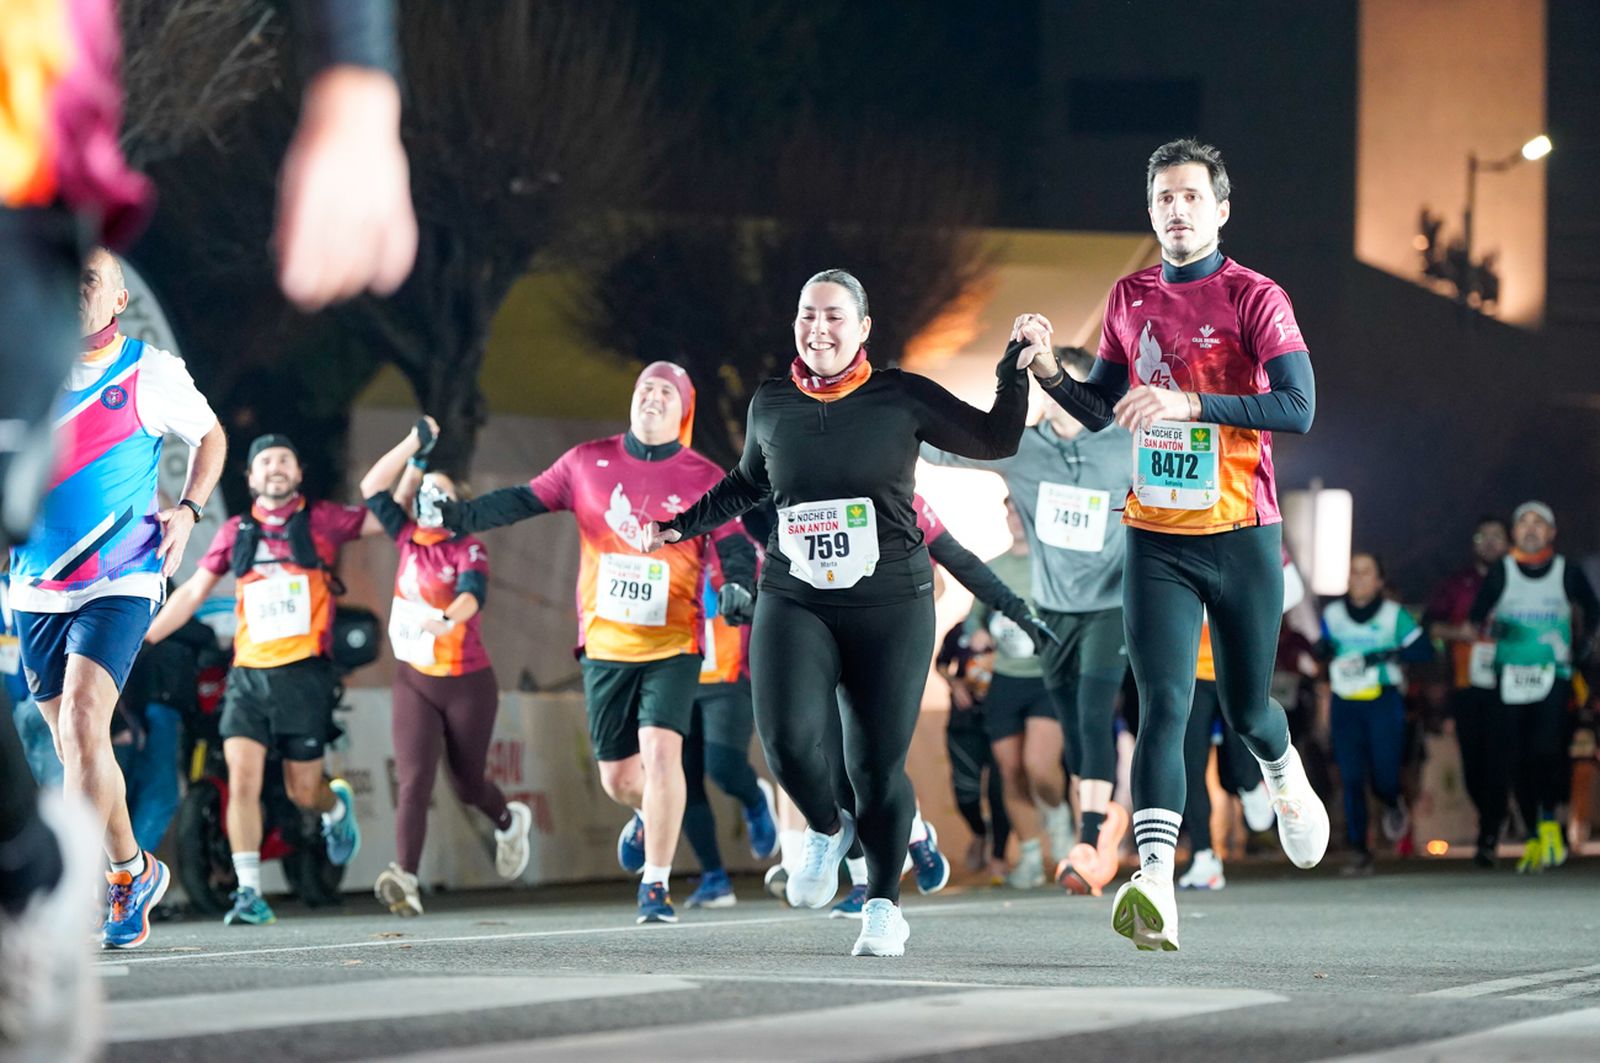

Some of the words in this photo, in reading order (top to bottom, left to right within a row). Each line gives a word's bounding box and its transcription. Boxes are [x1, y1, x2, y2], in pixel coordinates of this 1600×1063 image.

[1144, 438, 1158, 448] SAN
[1152, 429, 1172, 439] NOCHE
[1173, 431, 1183, 440] DE
[1151, 450, 1198, 479] 8472
[797, 511, 825, 522] NOCHE
[826, 510, 838, 520] DE
[1053, 508, 1089, 528] 7491
[619, 520, 638, 540] 43
[788, 524, 806, 535] SAN
[804, 532, 850, 561] 759
[610, 579, 652, 601] 2799
